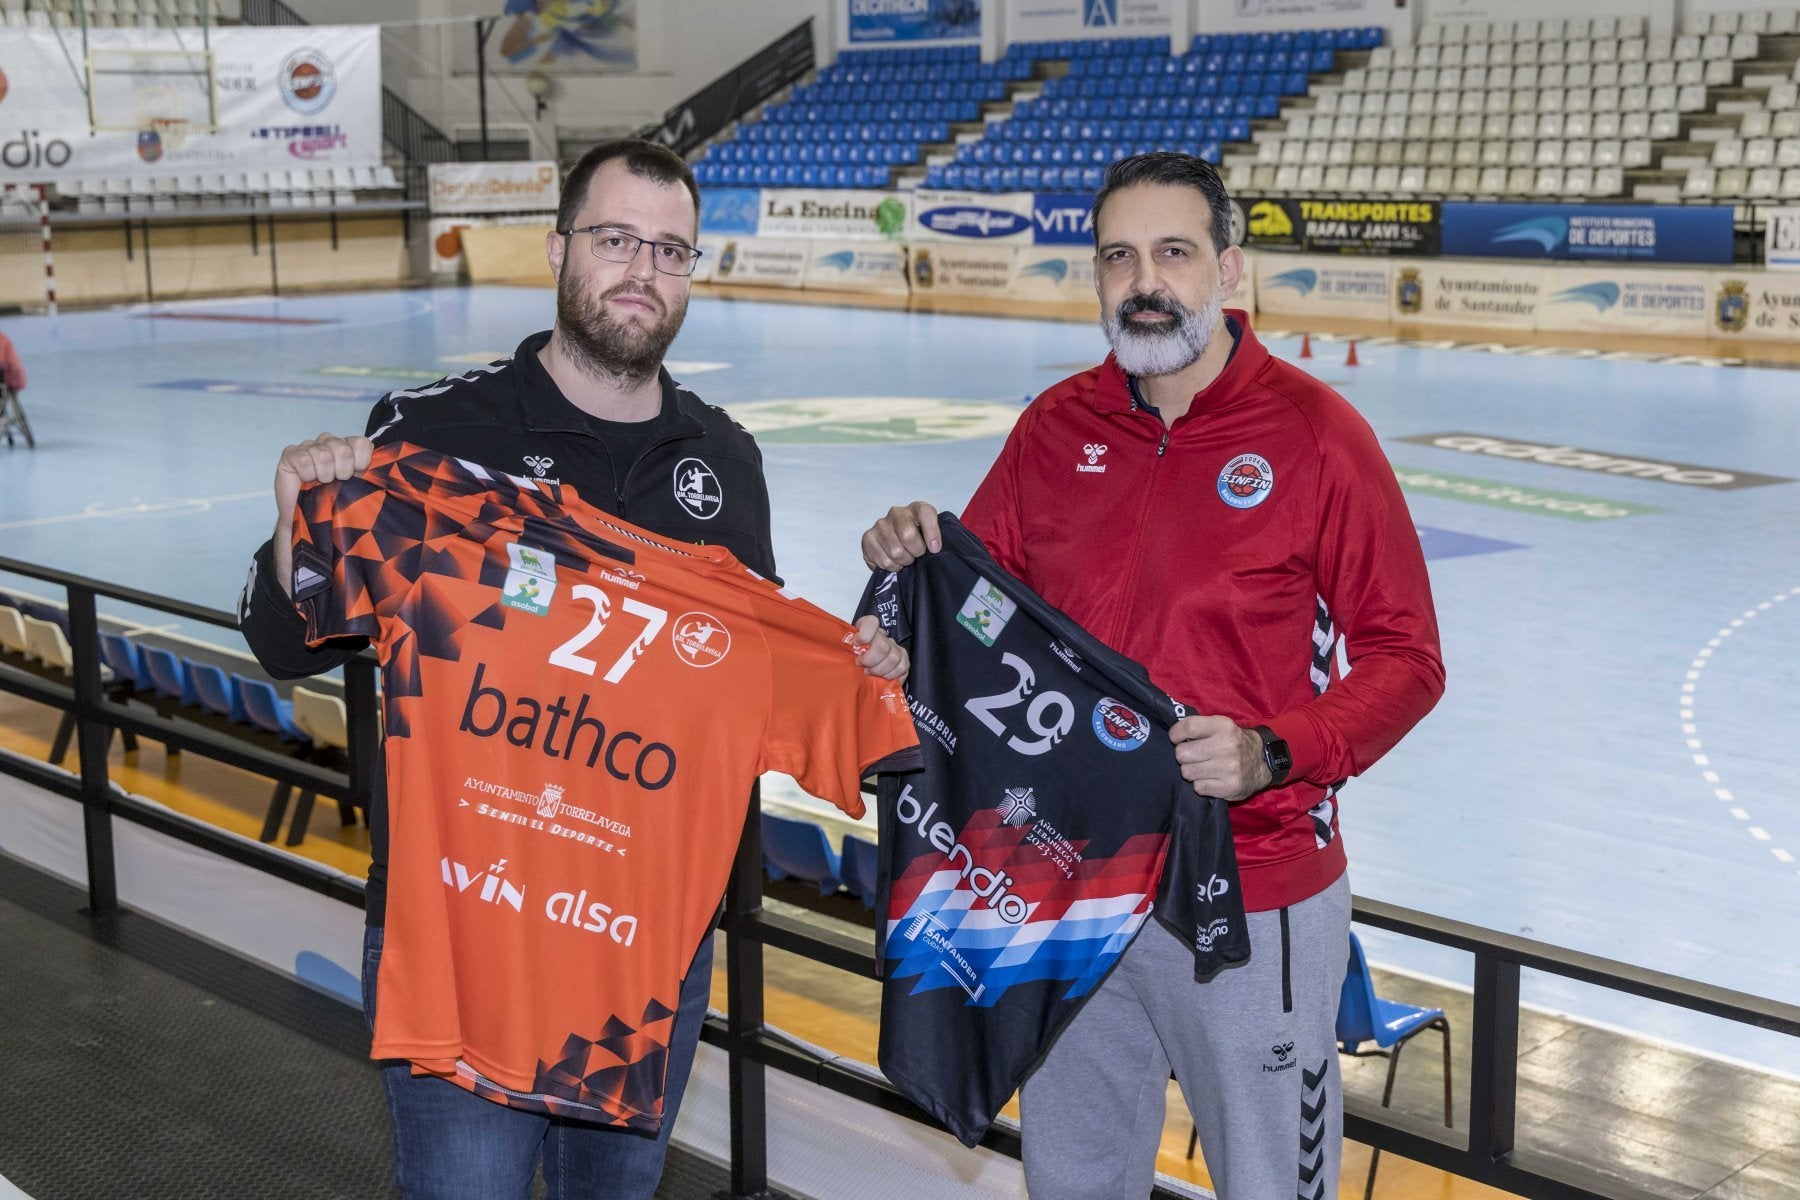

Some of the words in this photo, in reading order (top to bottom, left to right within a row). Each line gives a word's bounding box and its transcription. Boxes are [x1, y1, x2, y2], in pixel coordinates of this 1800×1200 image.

[768, 201, 795, 217] La
[801, 202, 882, 219] Encina
[1300, 202, 1433, 222] TRANSPORTES
[1306, 222, 1348, 237] RAFA
[1349, 224, 1361, 237] Y
[1362, 223, 1400, 239] JAVI
[1569, 228, 1586, 245] DE
[1588, 229, 1656, 247] DEPORTES
[1436, 277, 1538, 294] Ayuntamiento
[1434, 296, 1451, 310] de
[1461, 296, 1535, 314] Santander
[1622, 294, 1637, 309] DE
[1641, 294, 1706, 311] DEPORTES
[1755, 311, 1775, 327] de
[1076, 463, 1106, 473] hummel
[600, 569, 641, 591] hummel
[510, 600, 539, 613] asobal
[548, 584, 668, 684] 27
[963, 620, 986, 641] asobal
[686, 638, 722, 658] TORRELAVEGA
[1049, 641, 1083, 673] hummel
[964, 652, 1075, 756] 29
[459, 662, 677, 790] bathco
[1095, 720, 1127, 748] BALONMANO
[464, 777, 540, 808] AYUNTAMIENTO
[560, 803, 632, 838] TORRELAVEGA
[478, 803, 528, 826] SENTIR
[530, 819, 545, 831] EL
[549, 823, 614, 853] DEPORTE
[1032, 824, 1073, 863] LEBANIEGO
[1038, 819, 1056, 835] AÑO
[1054, 832, 1083, 863] JUBILAR
[896, 784, 1028, 924] blendio
[545, 890, 638, 947] alsa
[922, 935, 944, 953] CIUDAD
[927, 928, 977, 982] SANTANDER
[1263, 1057, 1297, 1073] hummel
